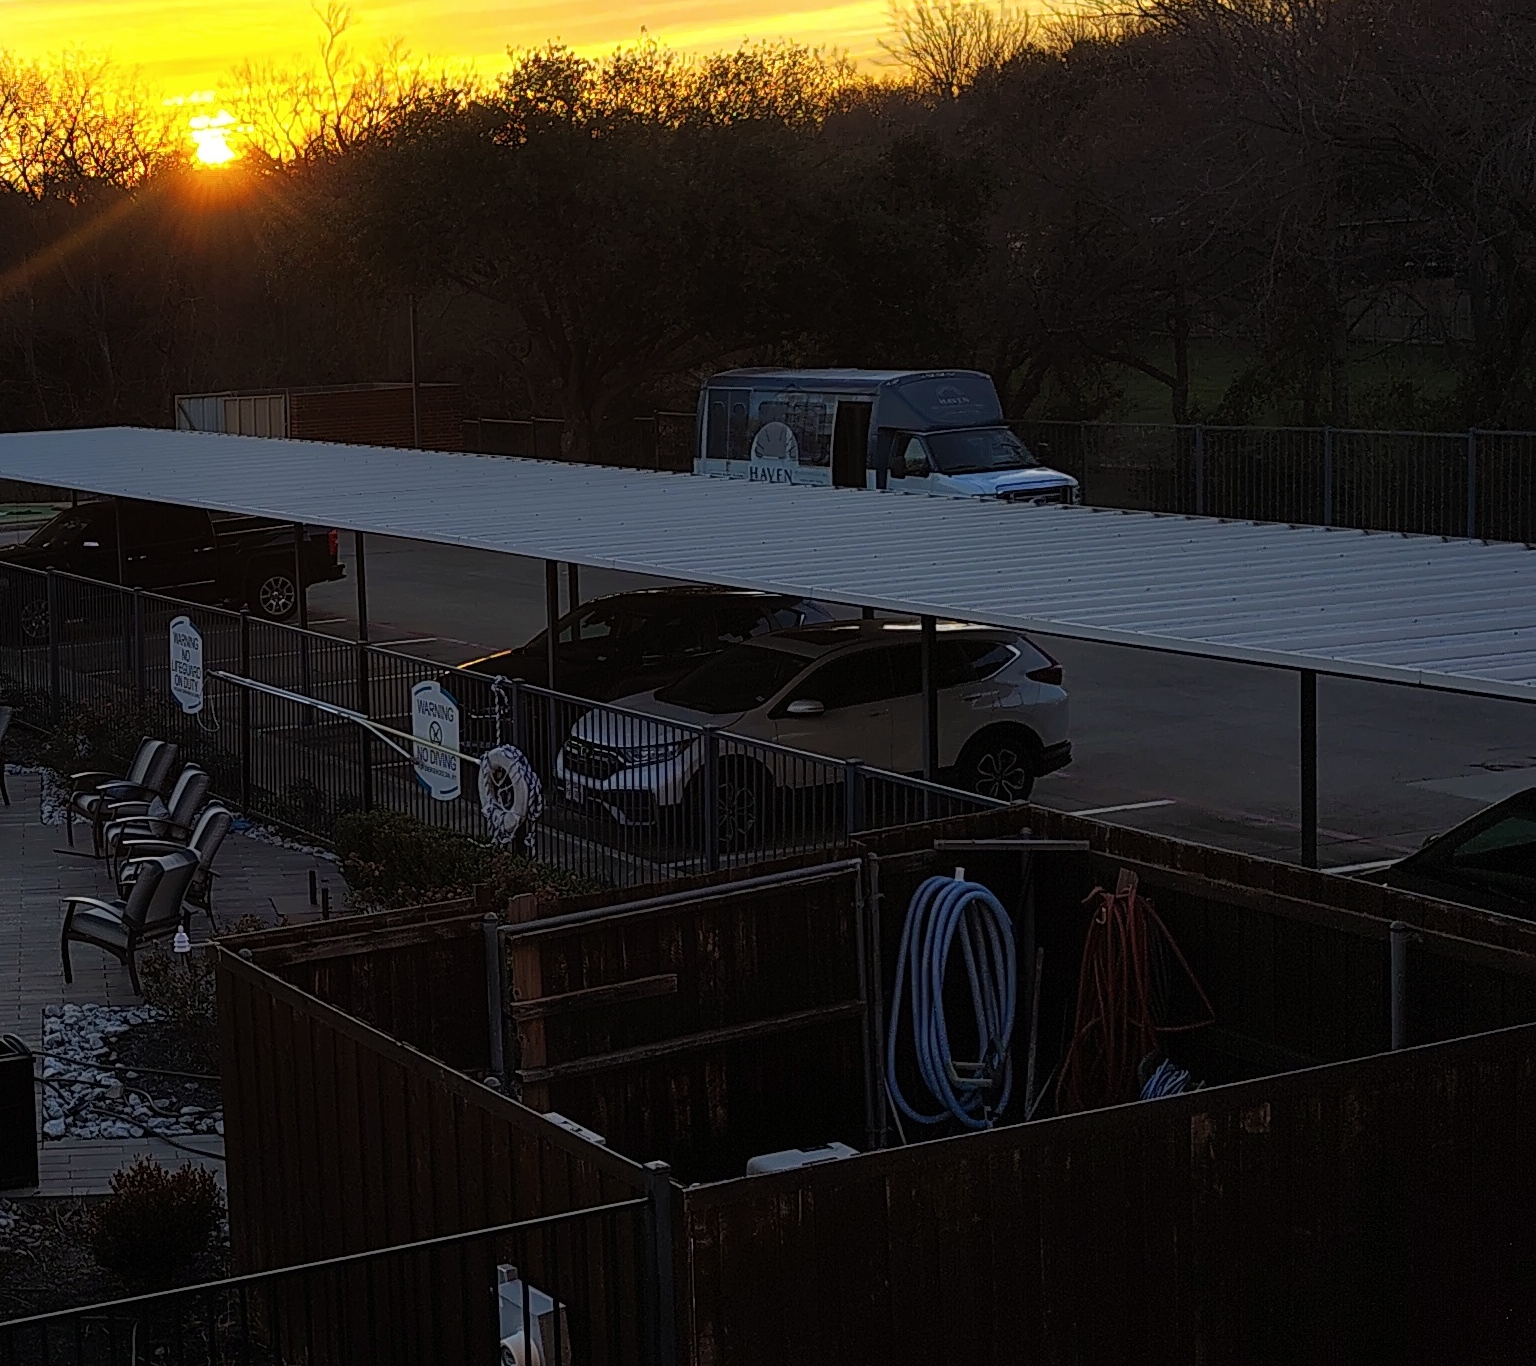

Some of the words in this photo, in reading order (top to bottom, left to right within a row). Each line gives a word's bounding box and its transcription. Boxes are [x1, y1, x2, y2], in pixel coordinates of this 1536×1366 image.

[749, 466, 793, 484] HAVEN
[173, 633, 198, 650] WARNING
[181, 649, 191, 662] NO
[172, 660, 201, 679] LIFEGUARD
[174, 674, 183, 687] ON
[184, 677, 199, 692] DUTY
[417, 699, 454, 722] WARNING
[417, 746, 429, 762] NO
[430, 750, 457, 771] DIVING
